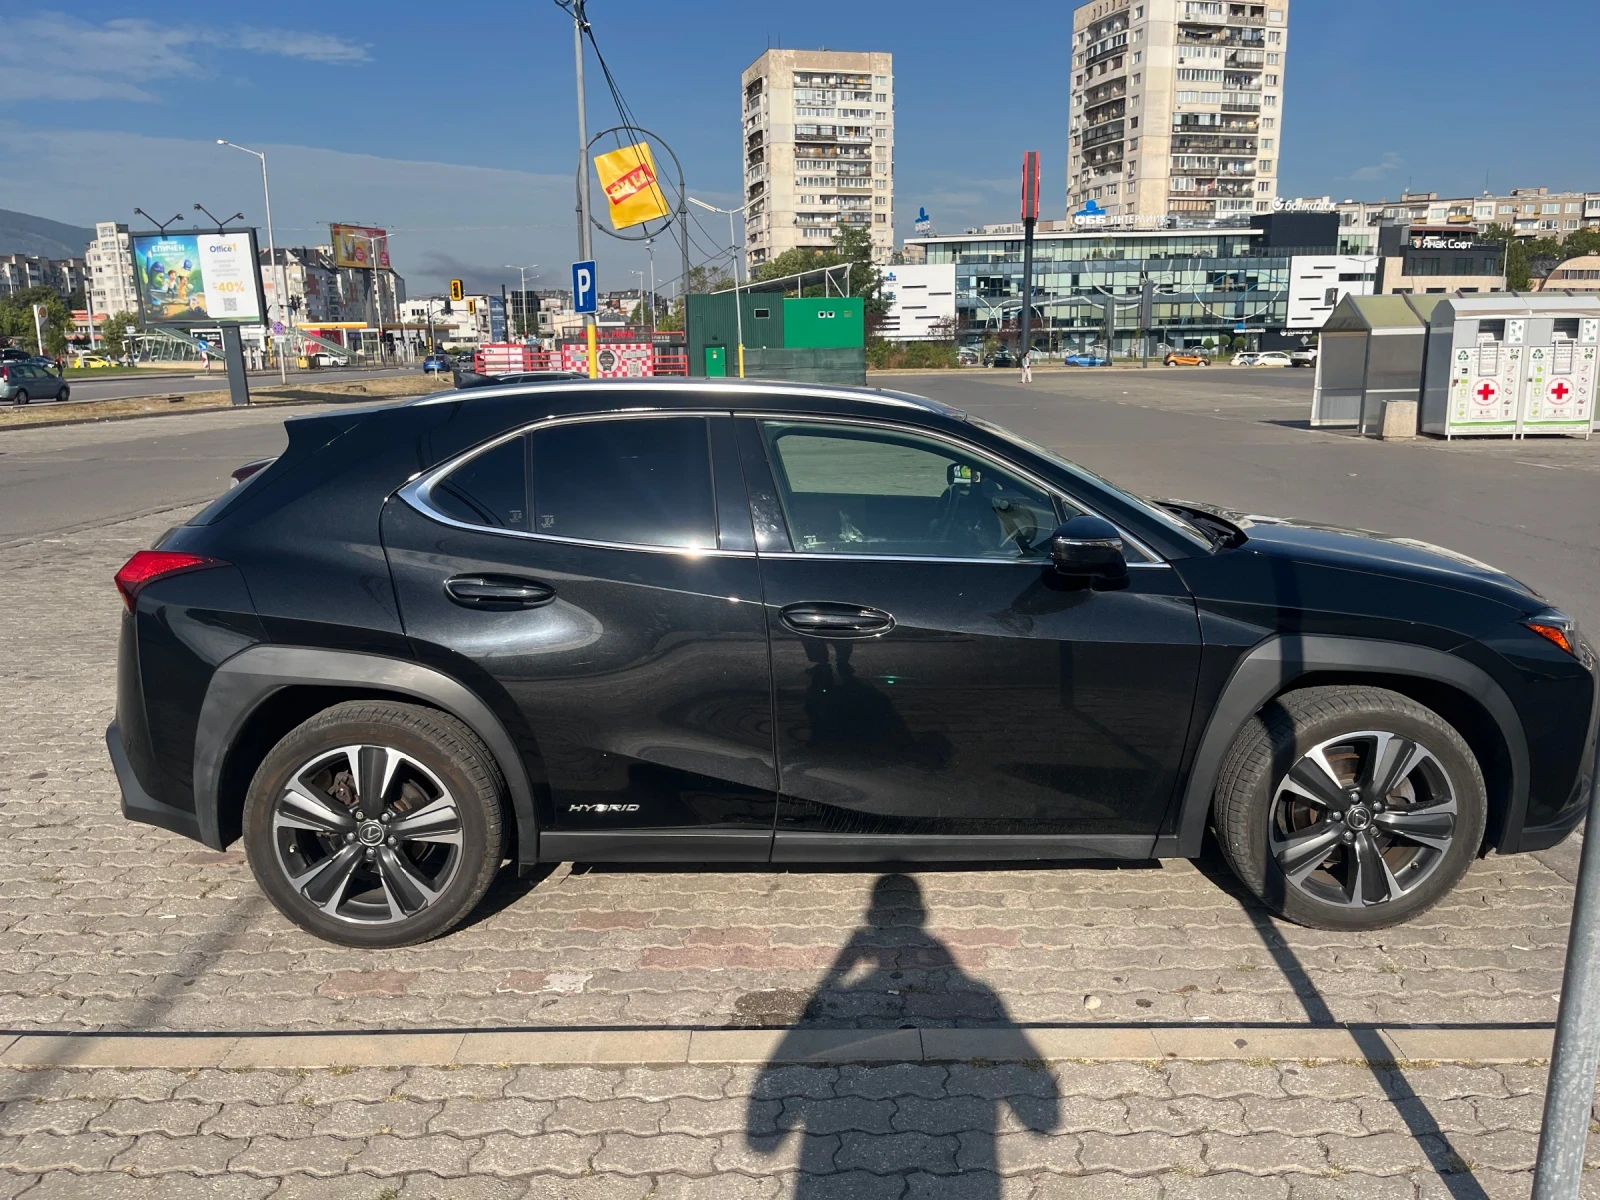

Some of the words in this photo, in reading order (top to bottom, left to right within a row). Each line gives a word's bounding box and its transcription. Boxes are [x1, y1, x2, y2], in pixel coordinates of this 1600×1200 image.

[1074, 215, 1106, 225] ОББ
[1422, 239, 1447, 249] Янак
[1448, 239, 1472, 249] Софт
[212, 280, 245, 292] -40%
[577, 268, 591, 307] P
[568, 803, 640, 812] HYBRID
